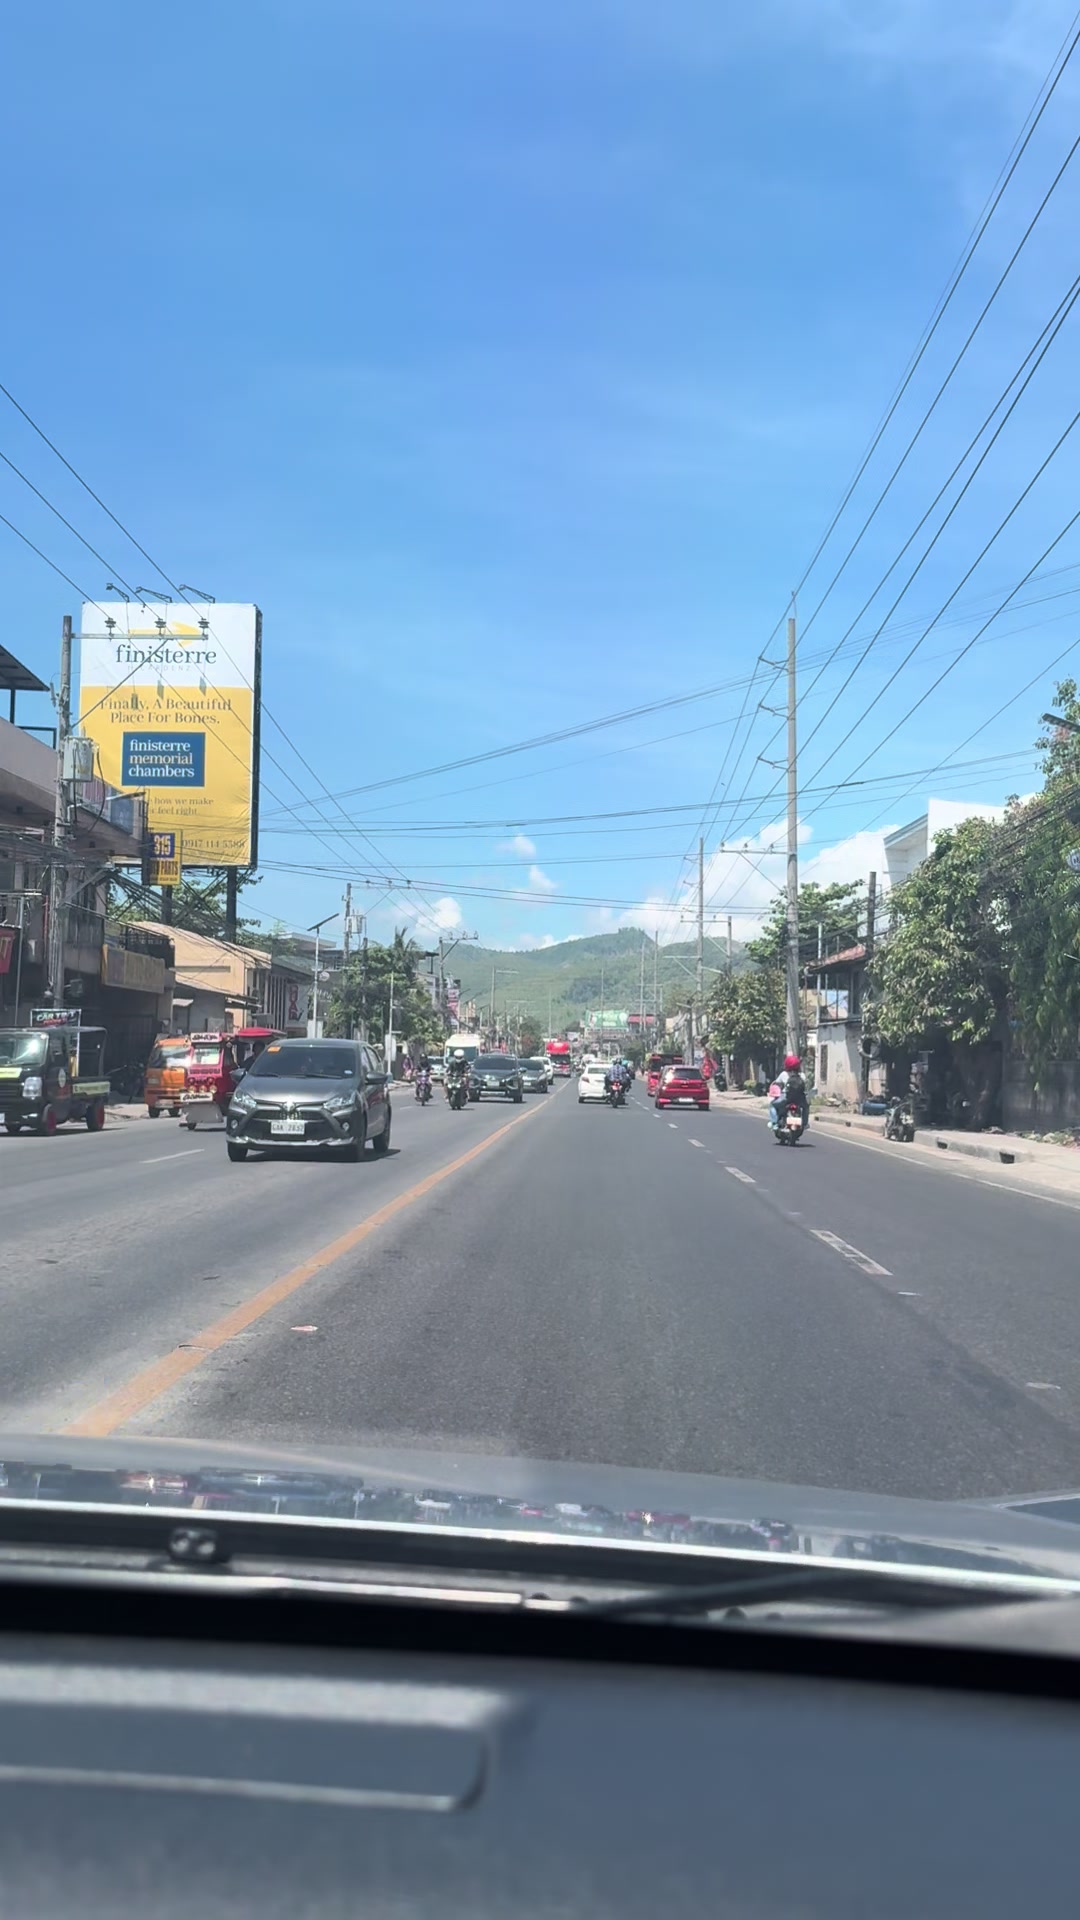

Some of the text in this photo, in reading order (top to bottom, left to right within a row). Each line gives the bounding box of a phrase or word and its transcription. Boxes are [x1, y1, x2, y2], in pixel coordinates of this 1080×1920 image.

[115, 644, 217, 664] finisterre
[153, 699, 162, 710] A
[166, 698, 232, 711] Beautiful
[110, 711, 221, 725] Place For Bones.
[129, 739, 191, 752] finisterre
[129, 752, 193, 765] memorial
[128, 764, 195, 778] chambers
[154, 796, 172, 805] how
[189, 797, 213, 805] make
[153, 834, 171, 856] 315
[160, 860, 179, 876] PARTS
